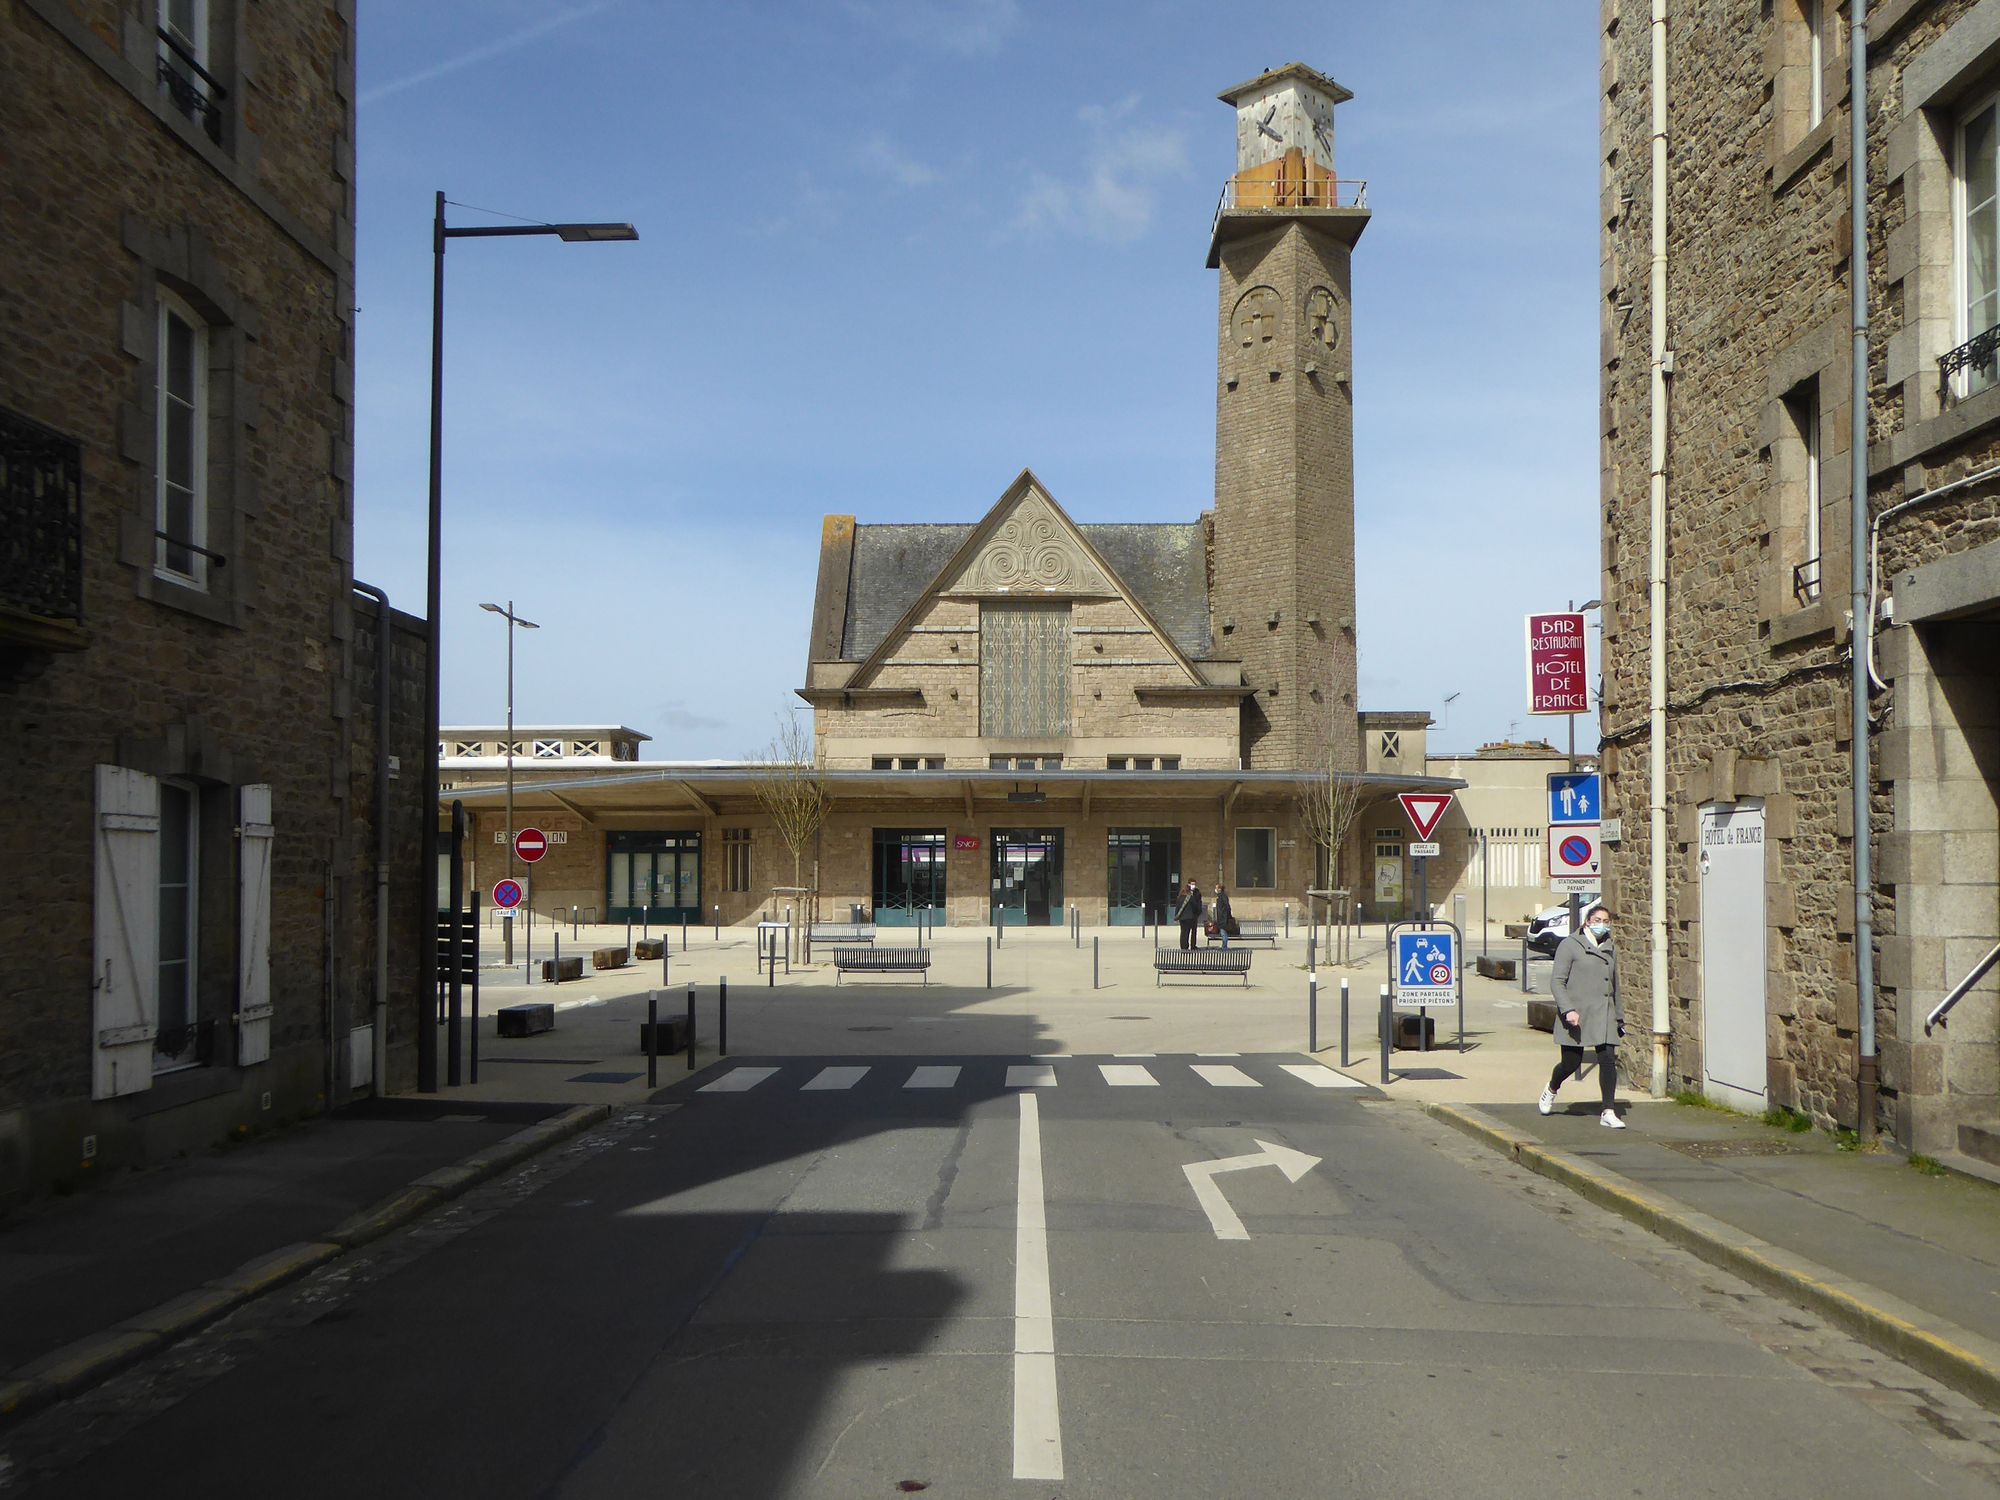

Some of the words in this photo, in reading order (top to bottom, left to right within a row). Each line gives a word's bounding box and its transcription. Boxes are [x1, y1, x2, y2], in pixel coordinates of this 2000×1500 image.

[1908, 575, 1916, 586] 2
[1541, 620, 1575, 634] BAR
[1532, 635, 1583, 651] RESTAURANT
[1535, 660, 1582, 675] HOTEL
[1550, 677, 1570, 691] DE
[1535, 693, 1585, 708] FRANCE
[1727, 828, 1734, 844] de
[1736, 826, 1762, 844] FRANCE
[956, 840, 978, 848] SNCF
[1434, 970, 1446, 978] 20
